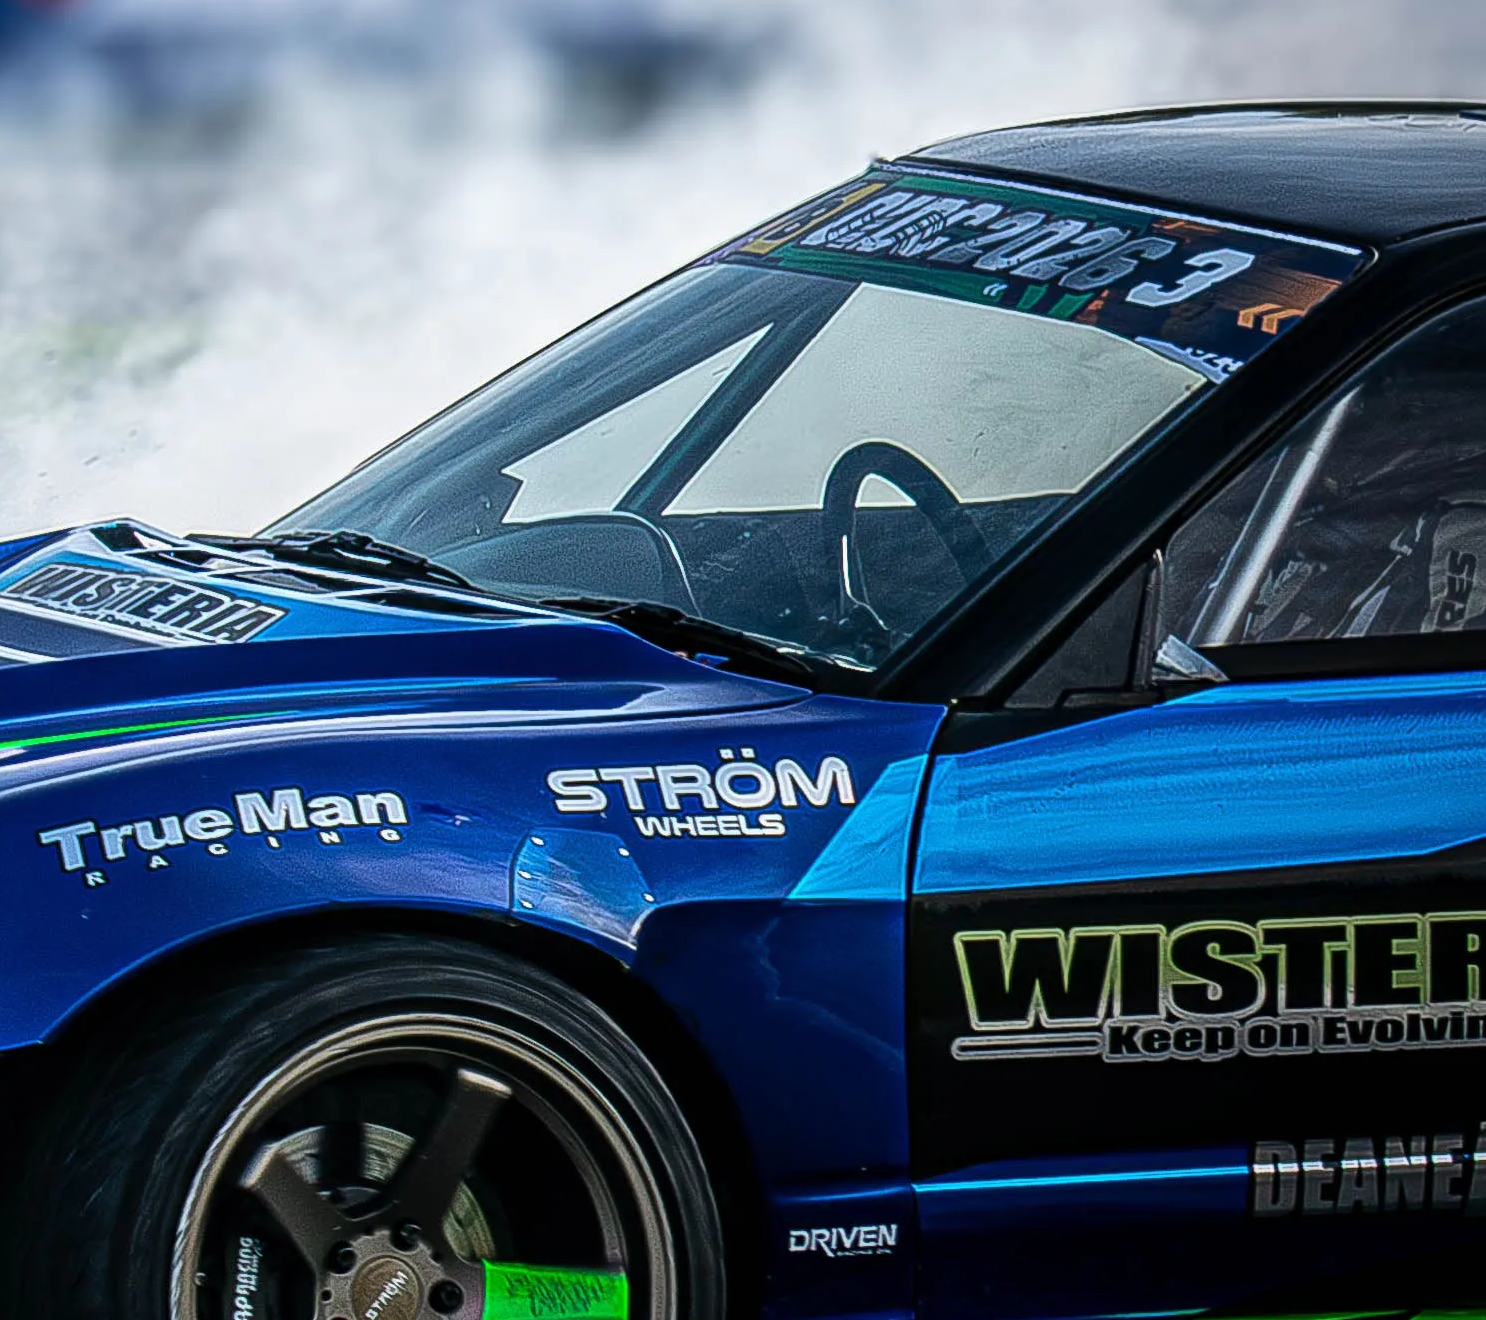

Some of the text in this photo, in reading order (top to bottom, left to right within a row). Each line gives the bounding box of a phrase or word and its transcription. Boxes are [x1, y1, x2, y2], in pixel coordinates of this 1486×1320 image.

[0, 565, 288, 643] WISTERIA
[548, 748, 856, 813] STRÖM
[39, 787, 408, 873] TrueMan
[634, 812, 787, 837] WHEELS
[85, 828, 401, 887] RACING
[1105, 1021, 1239, 1061] Keep
[1245, 1017, 1312, 1056] on
[1253, 1122, 1486, 1217] DEANE
[789, 1224, 898, 1257] DRIVEN
